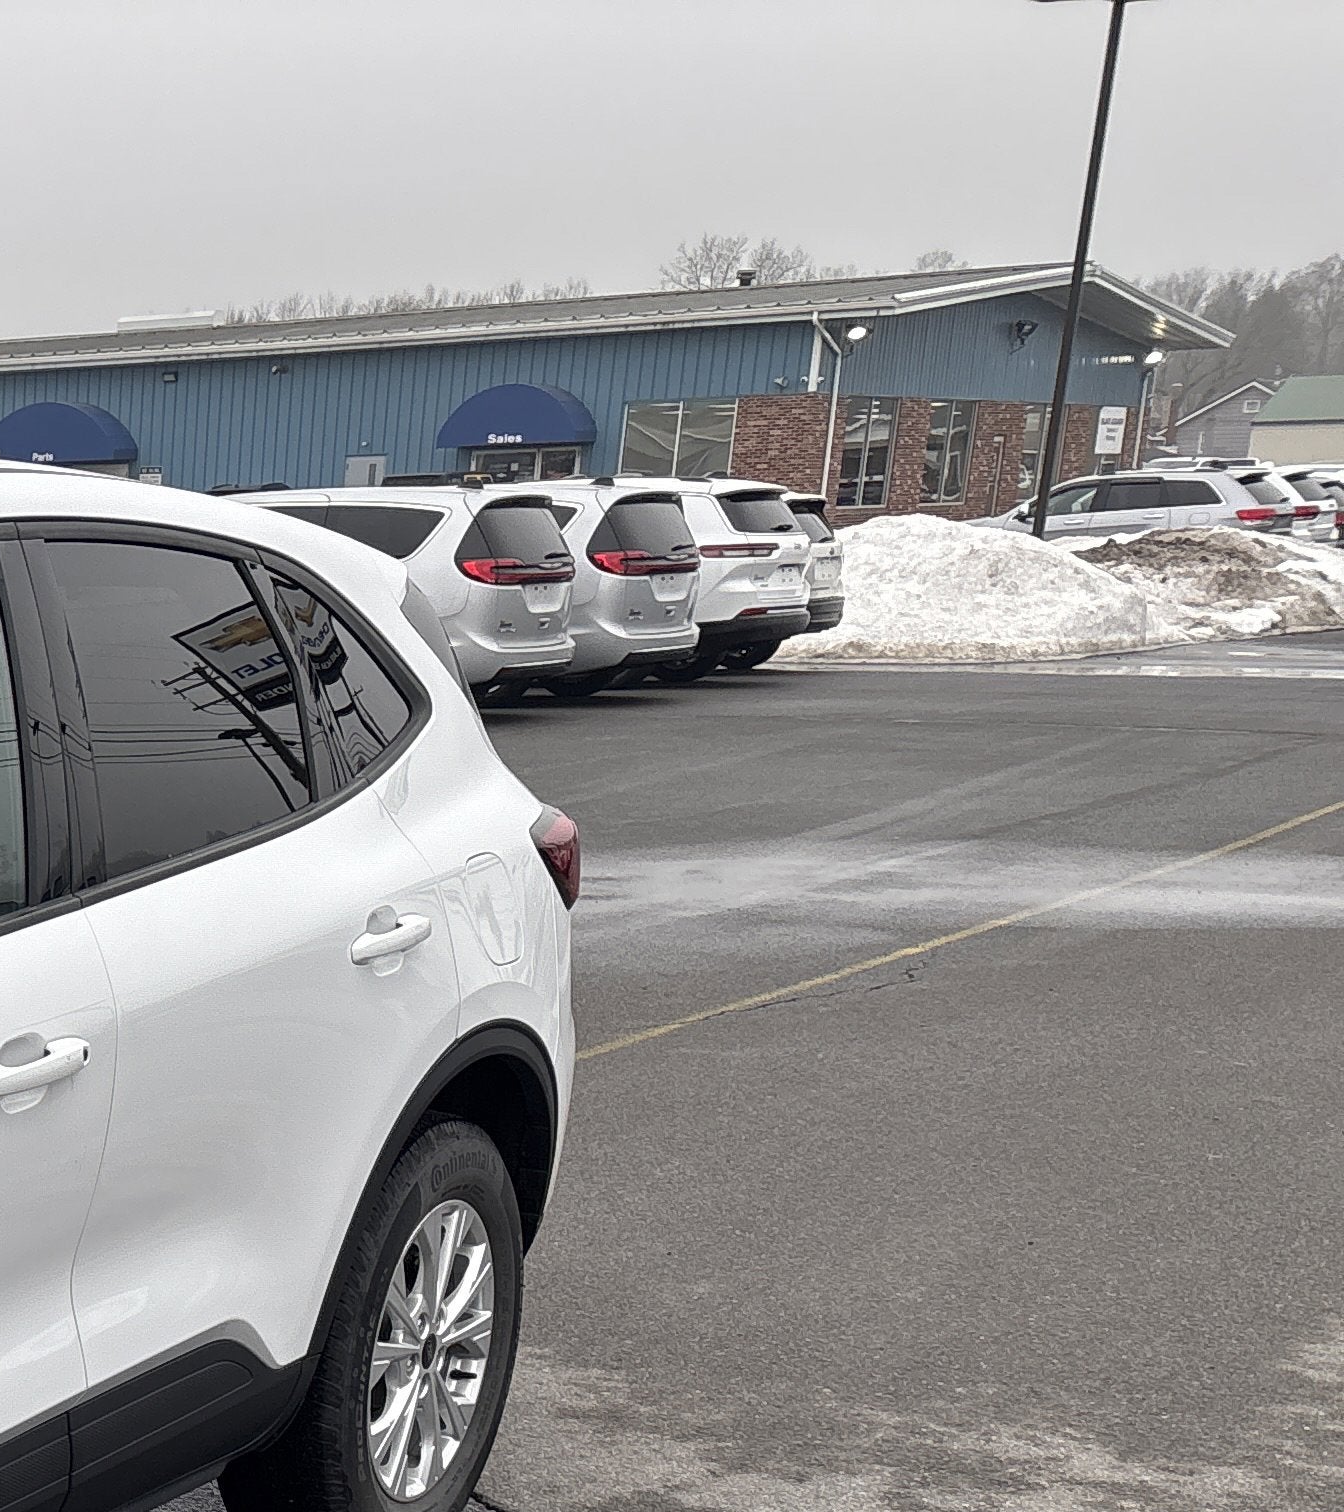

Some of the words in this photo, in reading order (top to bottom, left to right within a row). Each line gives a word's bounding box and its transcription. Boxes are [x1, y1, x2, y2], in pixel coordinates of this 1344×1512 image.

[487, 433, 523, 444] Sales
[32, 452, 54, 462] Parts
[431, 1150, 490, 1193] Continental
